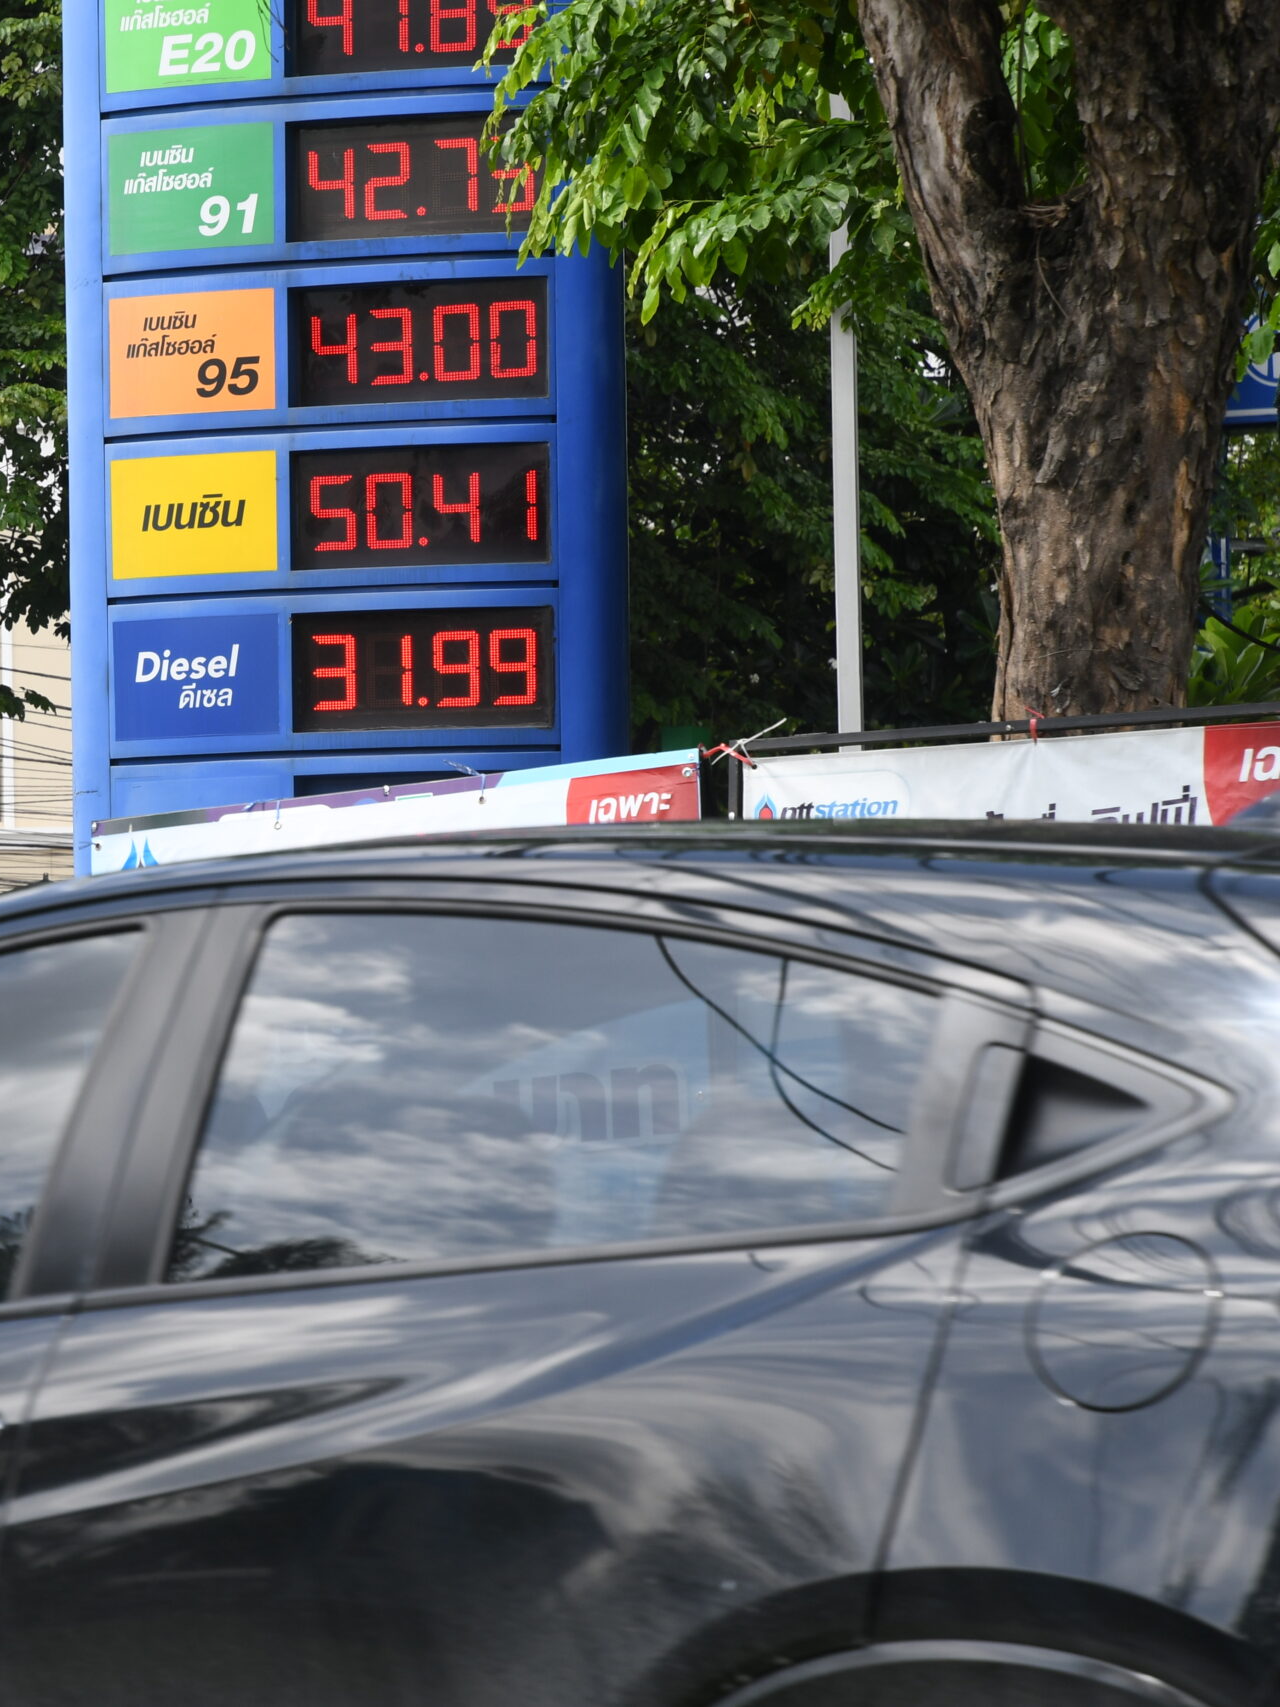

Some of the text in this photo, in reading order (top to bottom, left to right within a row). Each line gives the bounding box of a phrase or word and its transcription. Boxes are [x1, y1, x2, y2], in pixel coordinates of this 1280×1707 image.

[158, 29, 256, 77] E20
[140, 144, 194, 168] เบนซิน
[124, 167, 215, 195] แก๊สโซฮอล์
[198, 193, 259, 237] 91
[142, 310, 197, 333] เบนซิน
[126, 332, 217, 360] แก๊สโซฮอล์
[310, 299, 537, 386] 43.00
[195, 355, 261, 399] 95
[142, 493, 246, 533] เบนซิน
[310, 469, 538, 552] 50.41
[135, 643, 240, 684] Diesel
[312, 628, 537, 712] 31.99
[178, 684, 234, 710] ดีเซล
